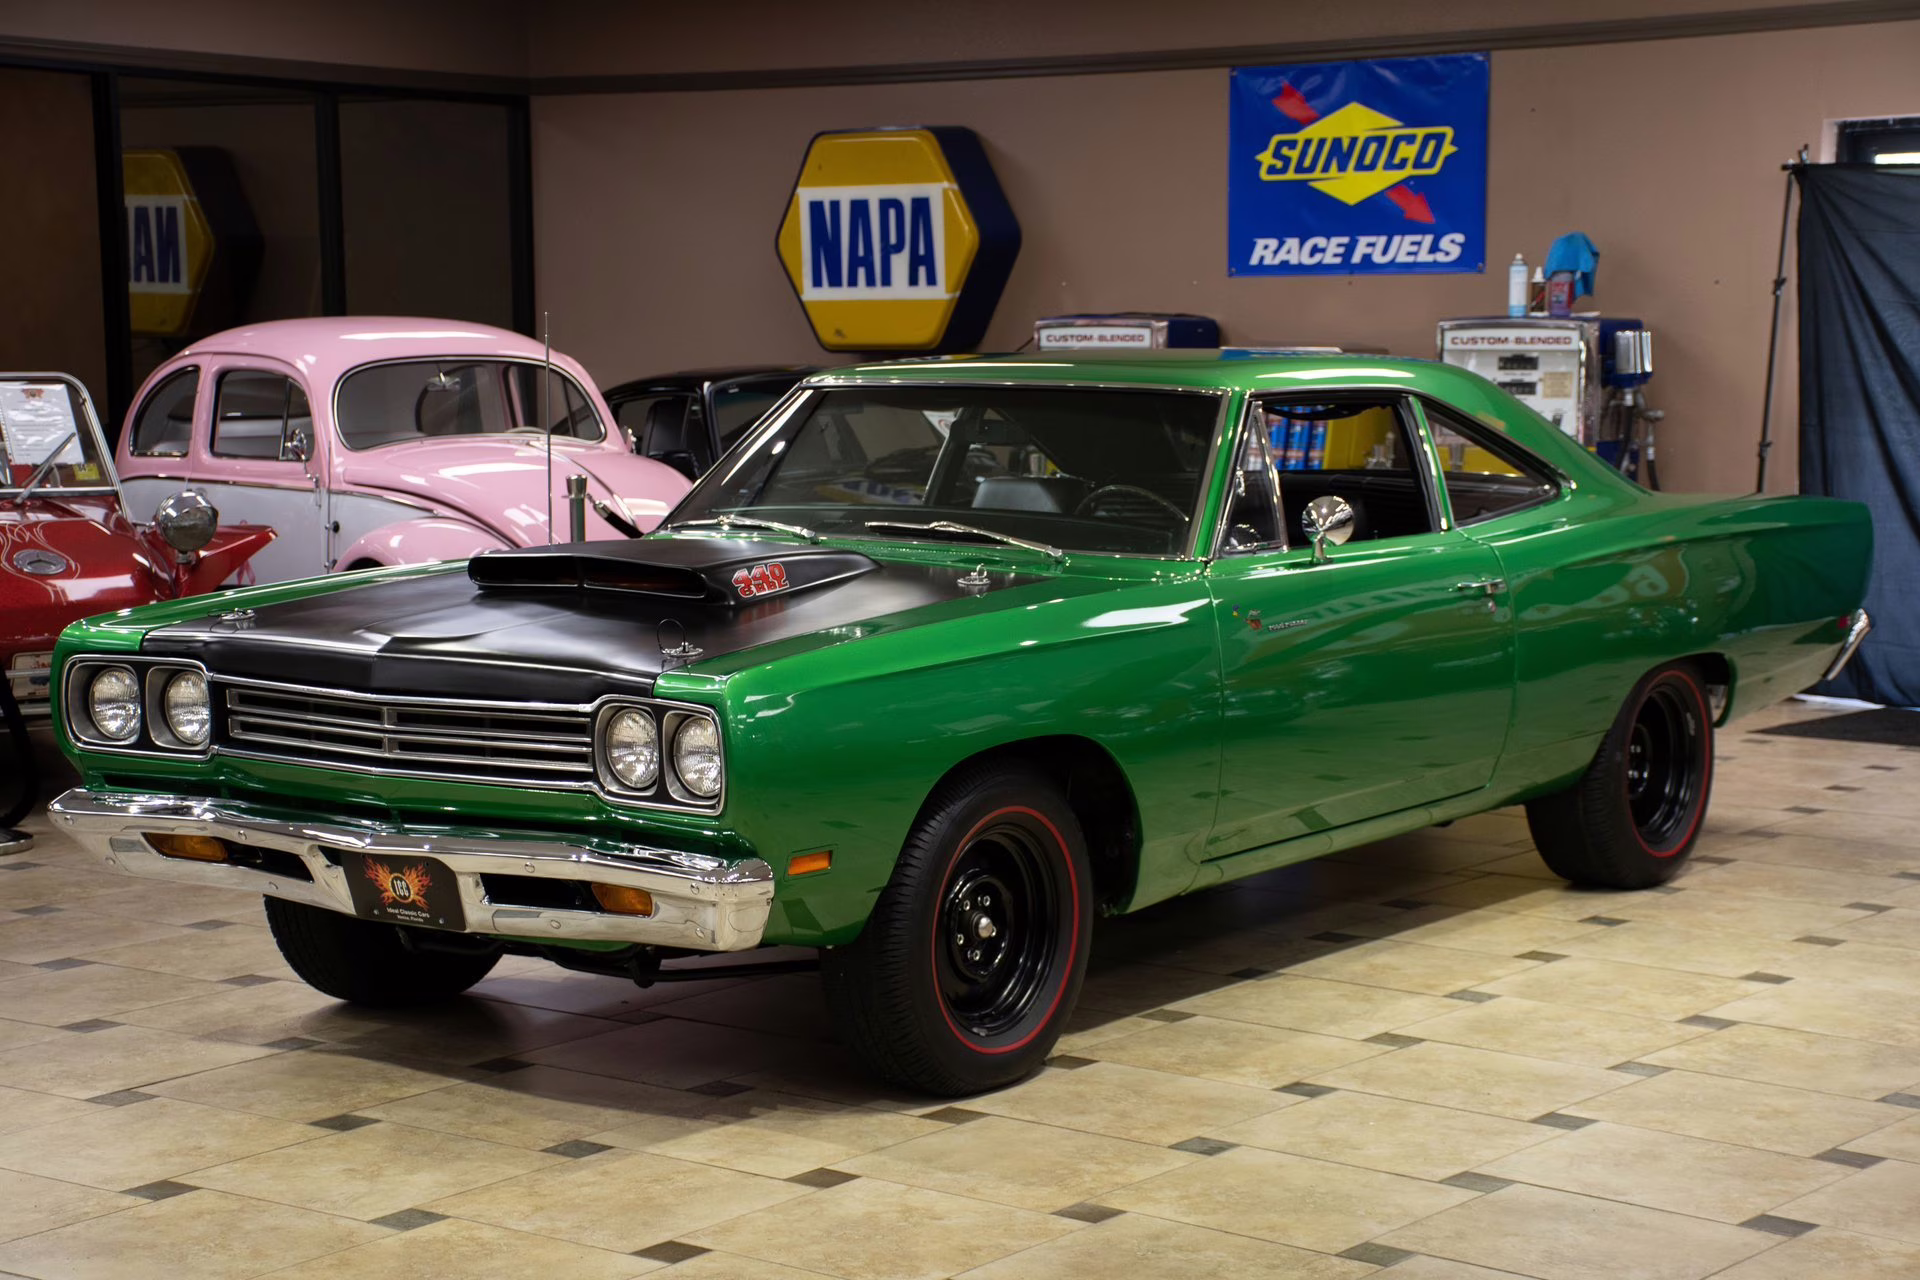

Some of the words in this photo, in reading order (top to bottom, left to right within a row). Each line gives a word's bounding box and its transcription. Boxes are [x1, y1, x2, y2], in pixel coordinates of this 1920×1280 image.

[1266, 133, 1448, 176] SUNOCO
[809, 197, 938, 288] NAPA
[1249, 237, 1350, 266] RACE
[1351, 233, 1466, 264] FUELS
[1450, 335, 1573, 346] CUSTOM-BLENDED
[732, 563, 786, 590] 440
